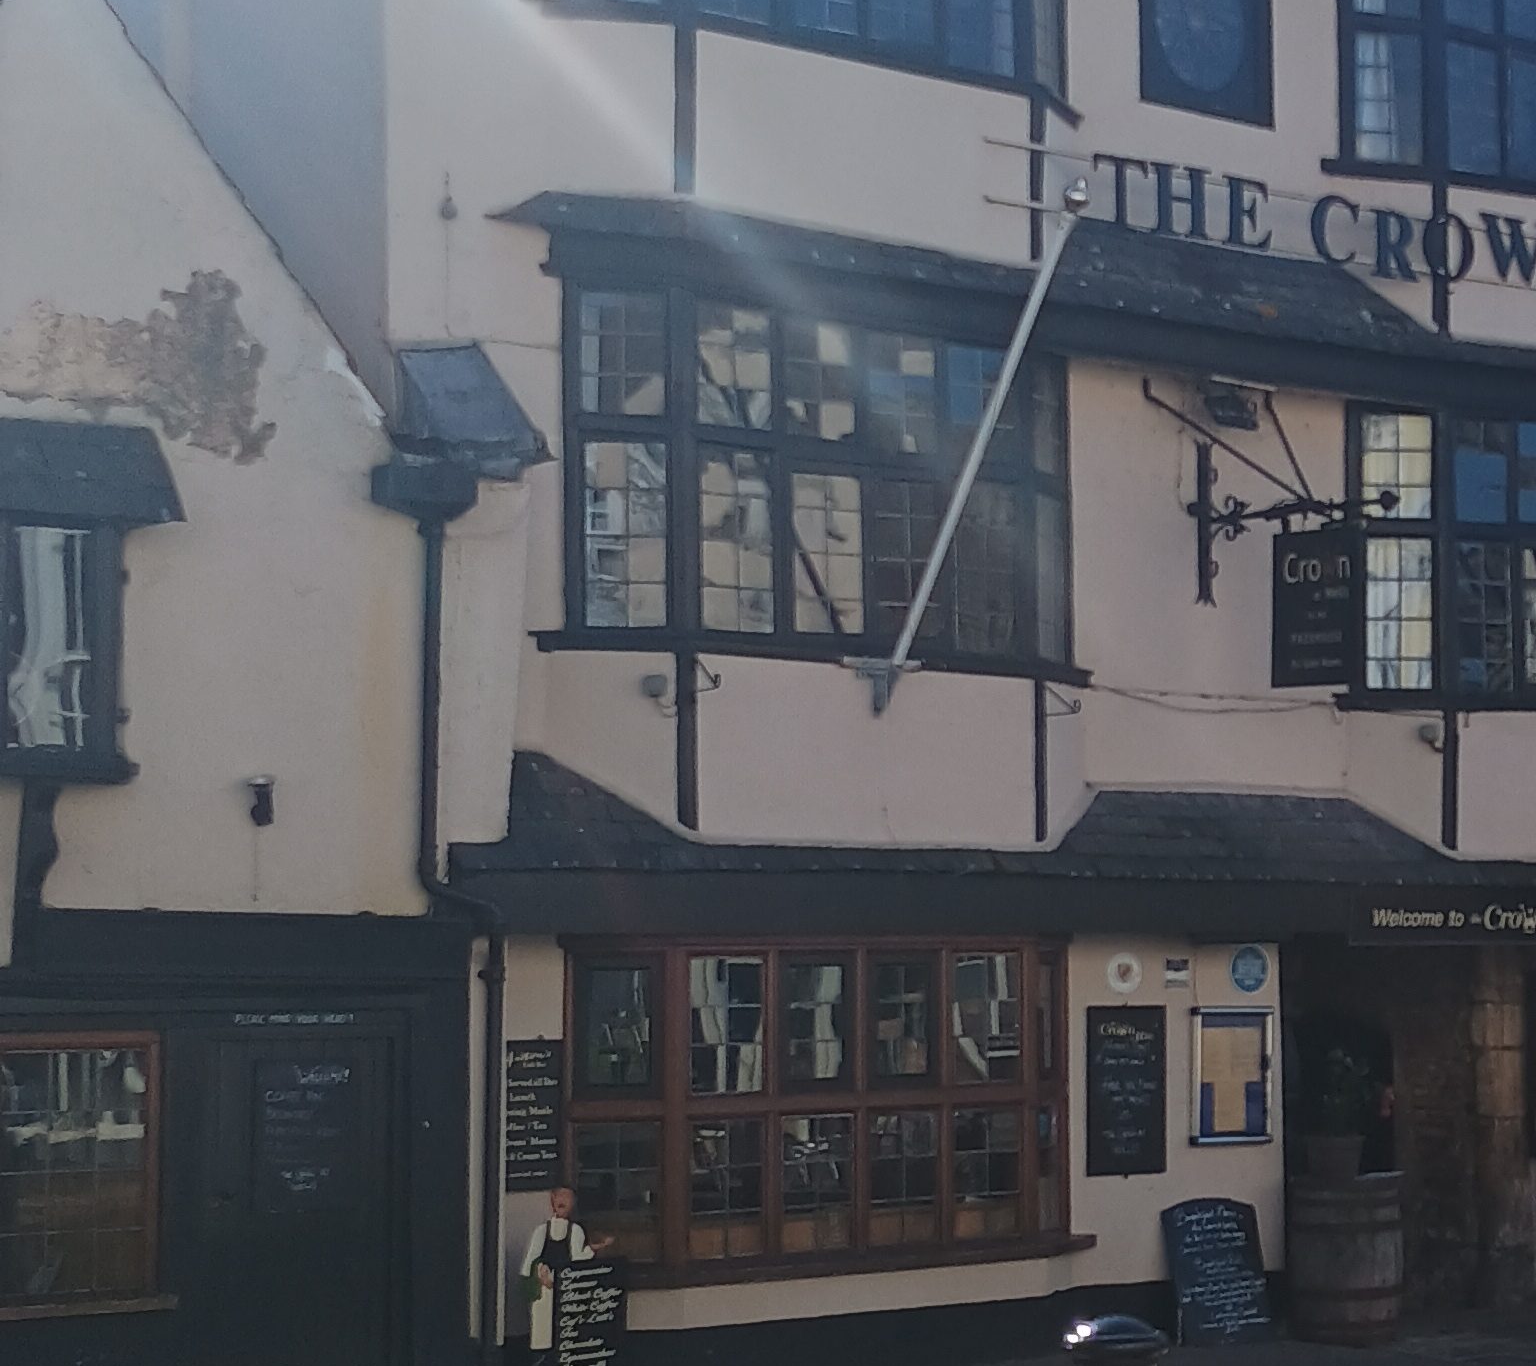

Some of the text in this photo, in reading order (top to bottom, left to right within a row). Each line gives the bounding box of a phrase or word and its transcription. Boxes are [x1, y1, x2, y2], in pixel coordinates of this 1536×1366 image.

[1091, 153, 1273, 251] THE
[1371, 906, 1445, 928] Welcome
[1448, 908, 1466, 928] to
